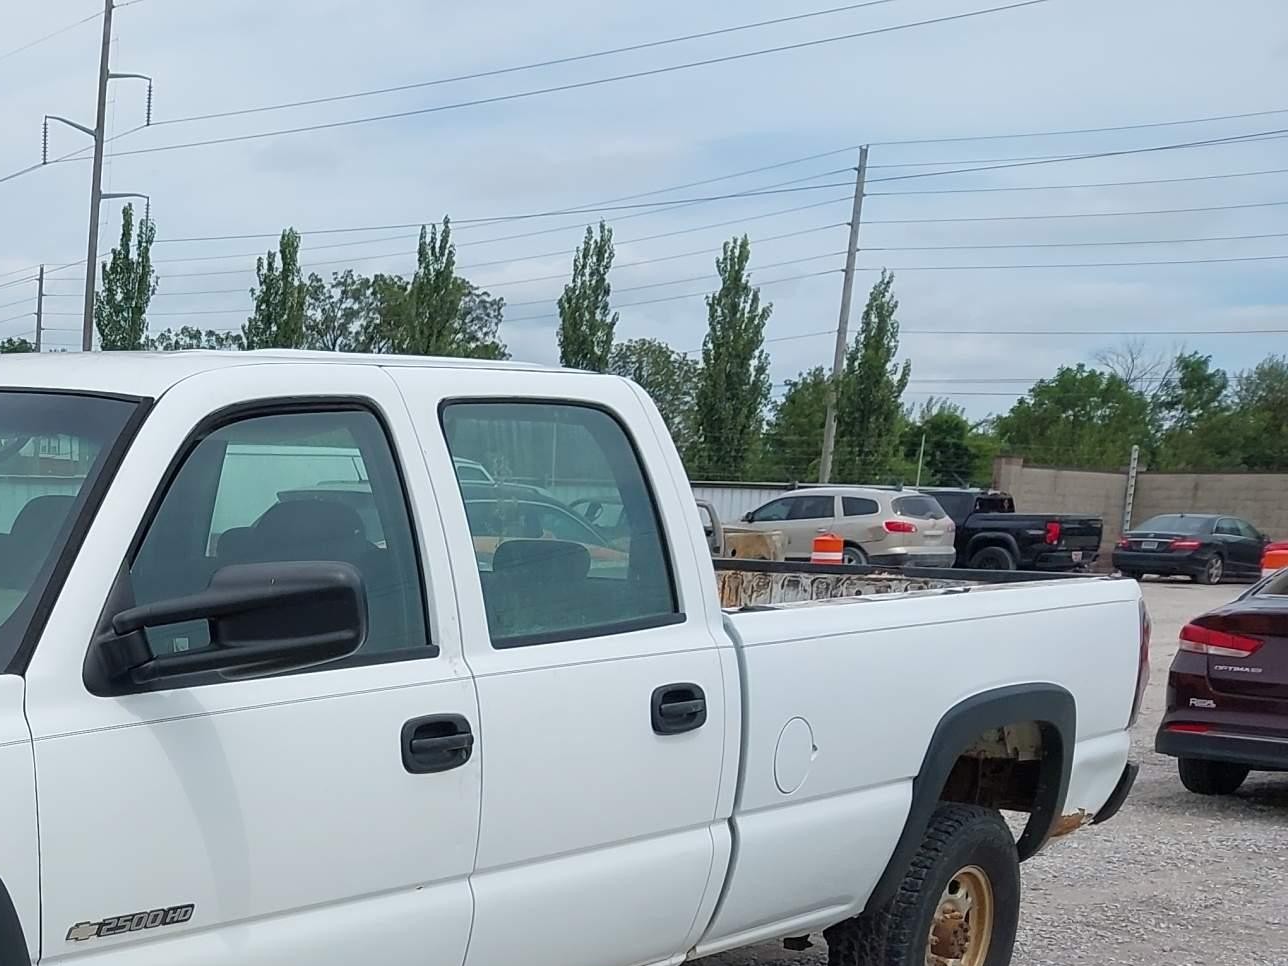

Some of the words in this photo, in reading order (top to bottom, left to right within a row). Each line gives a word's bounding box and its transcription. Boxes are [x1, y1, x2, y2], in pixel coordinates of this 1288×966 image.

[1214, 665, 1250, 673] OPTIMA
[99, 910, 164, 937] 2500
[166, 906, 193, 922] HD
